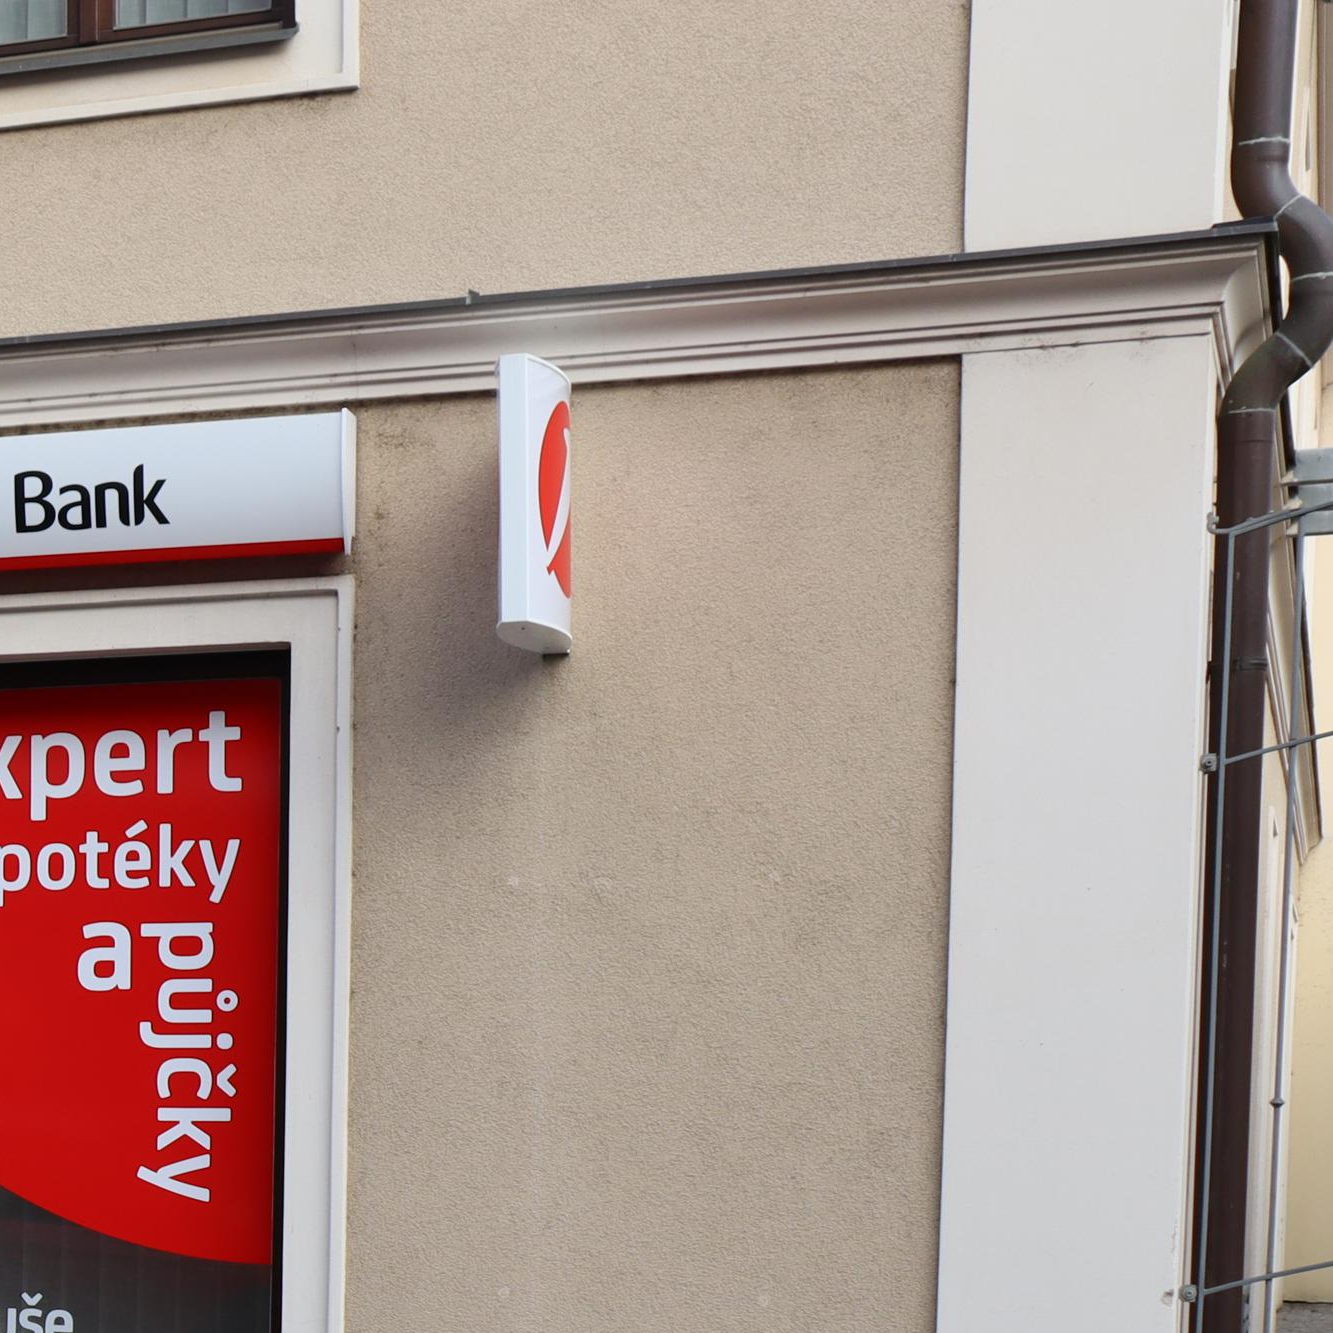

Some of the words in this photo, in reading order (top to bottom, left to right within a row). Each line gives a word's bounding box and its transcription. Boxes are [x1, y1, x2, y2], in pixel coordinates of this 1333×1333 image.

[13, 462, 172, 533] Bank
[76, 920, 132, 992] a
[136, 921, 239, 1203] půjčky
